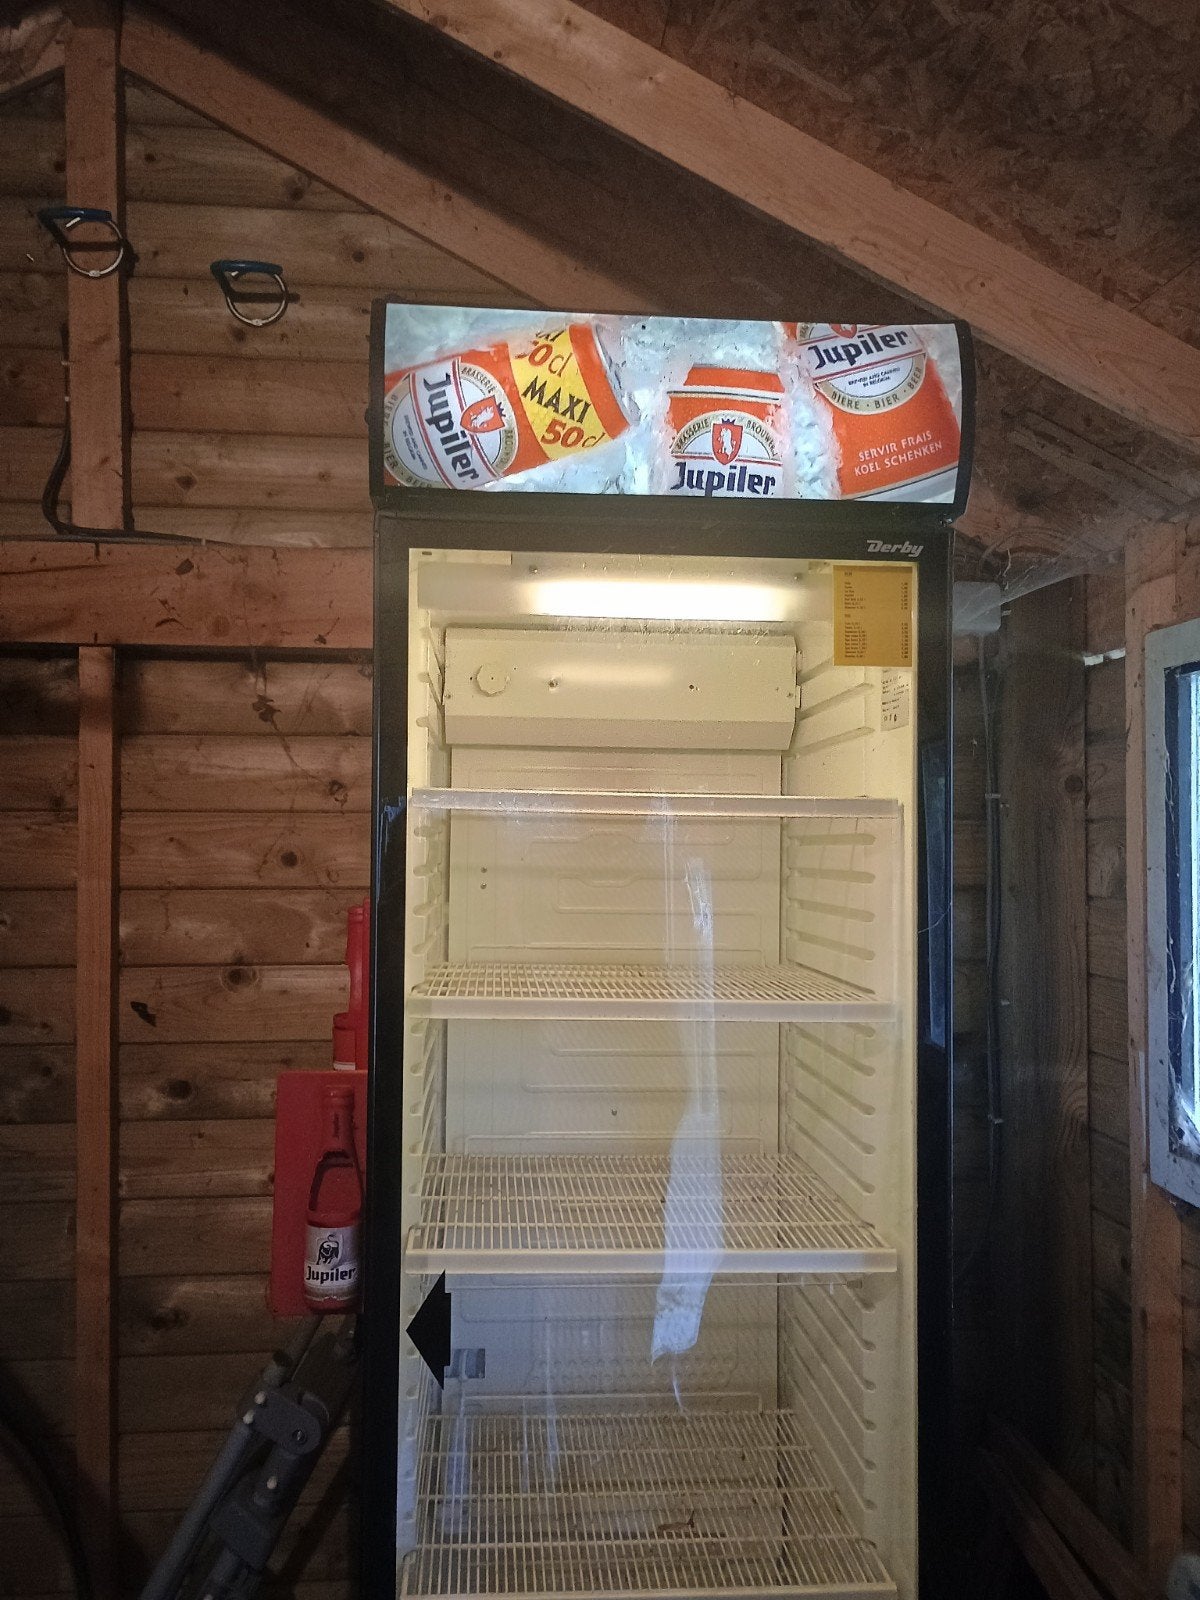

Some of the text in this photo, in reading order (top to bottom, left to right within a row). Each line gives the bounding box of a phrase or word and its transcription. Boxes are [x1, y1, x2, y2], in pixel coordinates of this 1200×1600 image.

[808, 330, 909, 370] Jupiler
[461, 366, 496, 395] BRASSERIE
[874, 393, 900, 409] BIER
[907, 366, 922, 389] BEER
[521, 375, 591, 424] MAXI
[423, 372, 481, 481] Jupiler
[676, 418, 710, 450] BRASSERIE
[854, 441, 943, 477] KOEL SCHENKEN
[858, 430, 932, 462] SERVIR FRAIS
[670, 461, 776, 496] Jupiler
[866, 539, 924, 558] Derby
[306, 1265, 357, 1285] Jupiler
